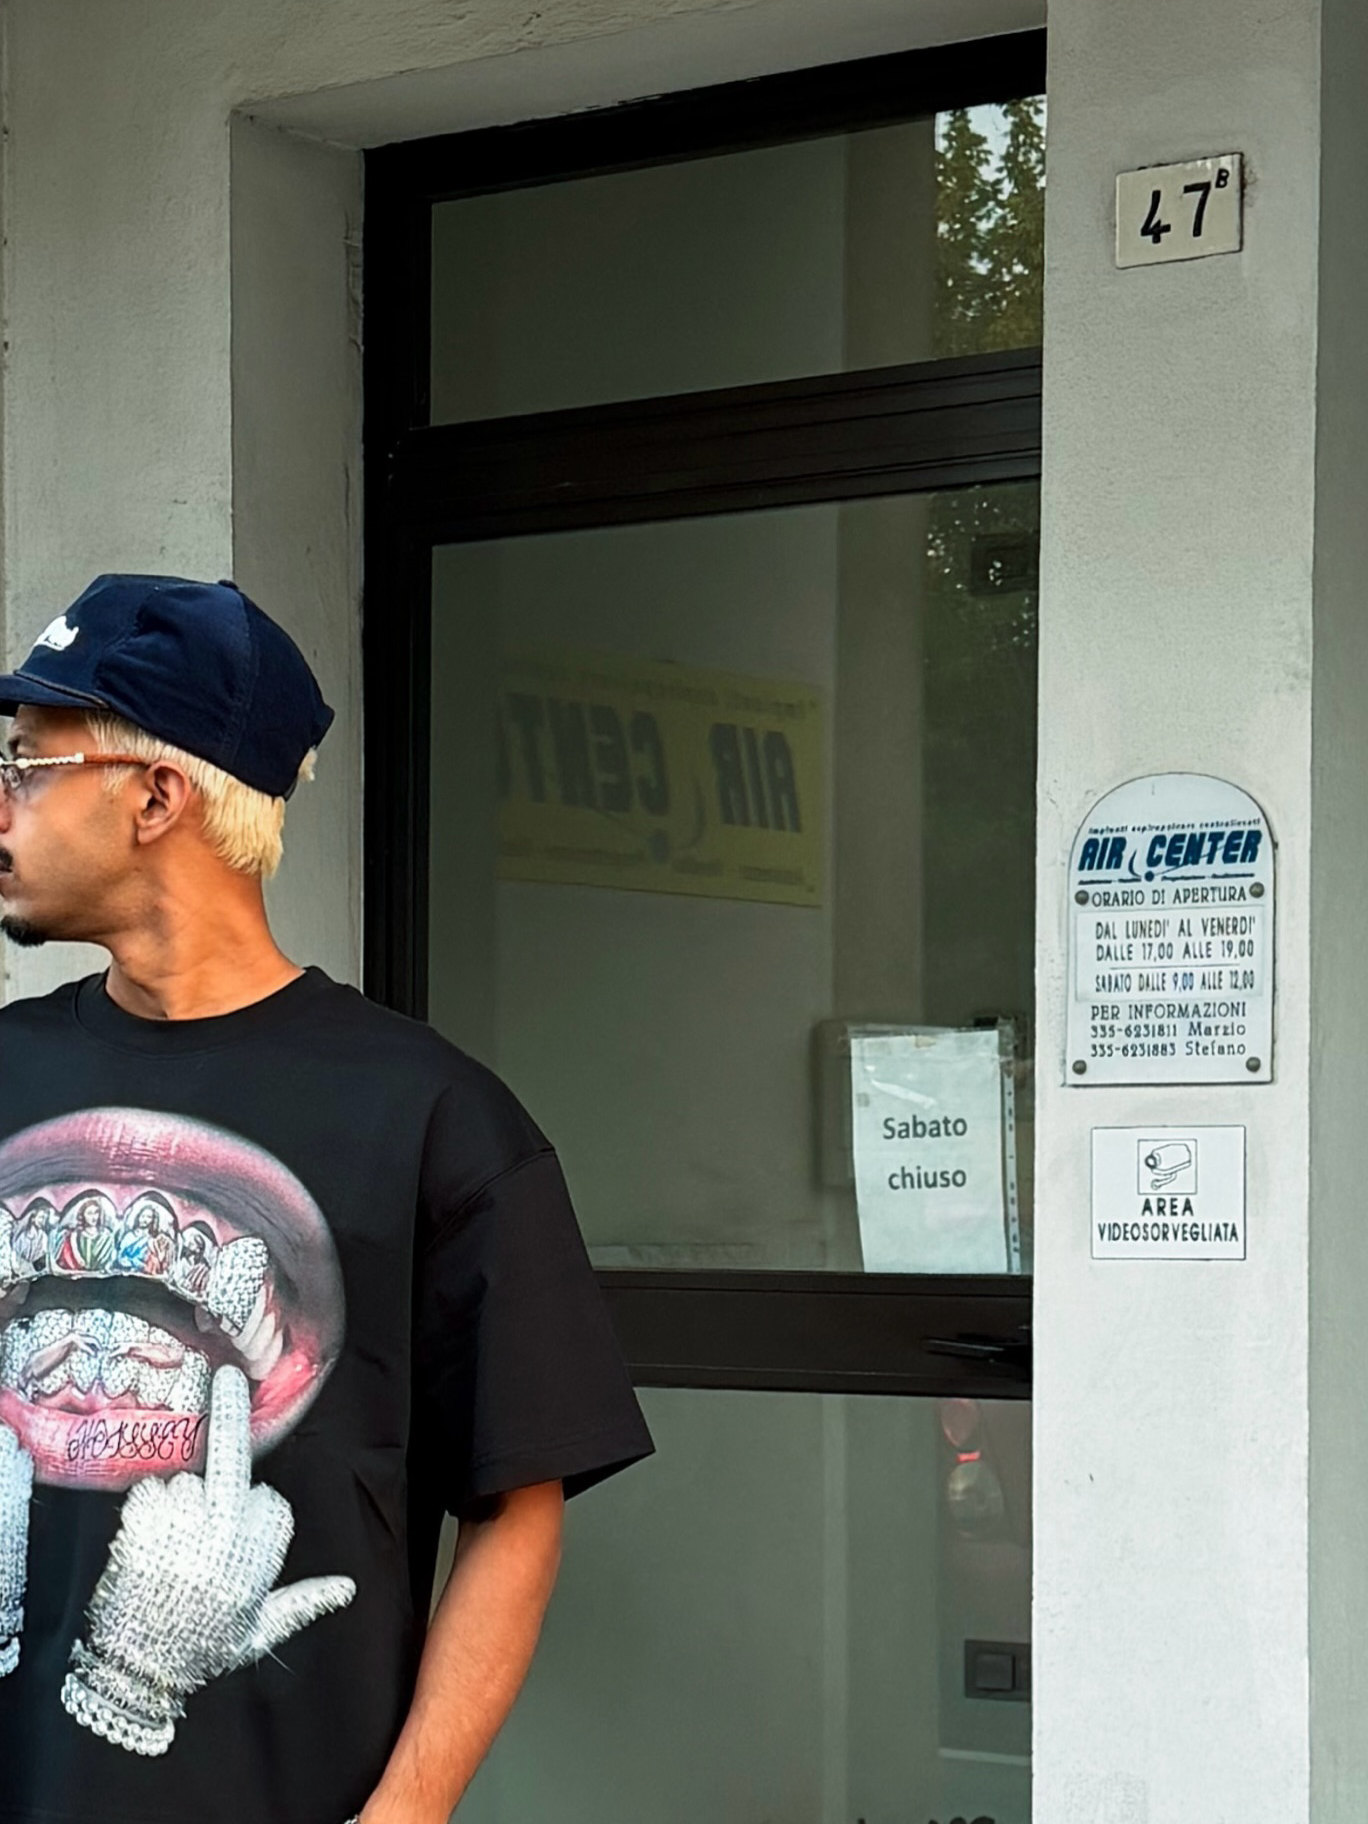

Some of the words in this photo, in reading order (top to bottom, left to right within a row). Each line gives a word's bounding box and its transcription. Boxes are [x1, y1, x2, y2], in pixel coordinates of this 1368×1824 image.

[1077, 836, 1127, 872] AIR
[1144, 829, 1264, 869] CENTER
[1091, 889, 1146, 908] ORARIO
[1151, 887, 1166, 906] DI
[1172, 885, 1248, 905] APERTURA
[1095, 920, 1118, 941] DAL
[1177, 918, 1194, 938] AL
[1095, 943, 1134, 962] DALLE
[1182, 940, 1213, 960] ALLE
[1094, 973, 1133, 994] SABATO
[1137, 972, 1167, 993] DALLE
[1199, 970, 1224, 991] ALLE
[1090, 1005, 1121, 1021] PER
[1128, 1002, 1248, 1021] INFORMAZIONI
[1187, 1021, 1247, 1037] Marzio
[1184, 1040, 1247, 1056] Stefano
[882, 1114, 968, 1140] Sabato
[887, 1165, 968, 1191] chiuso
[1140, 1197, 1195, 1217] AREA
[1097, 1222, 1240, 1243] VIDEOSORVEGLIATA
